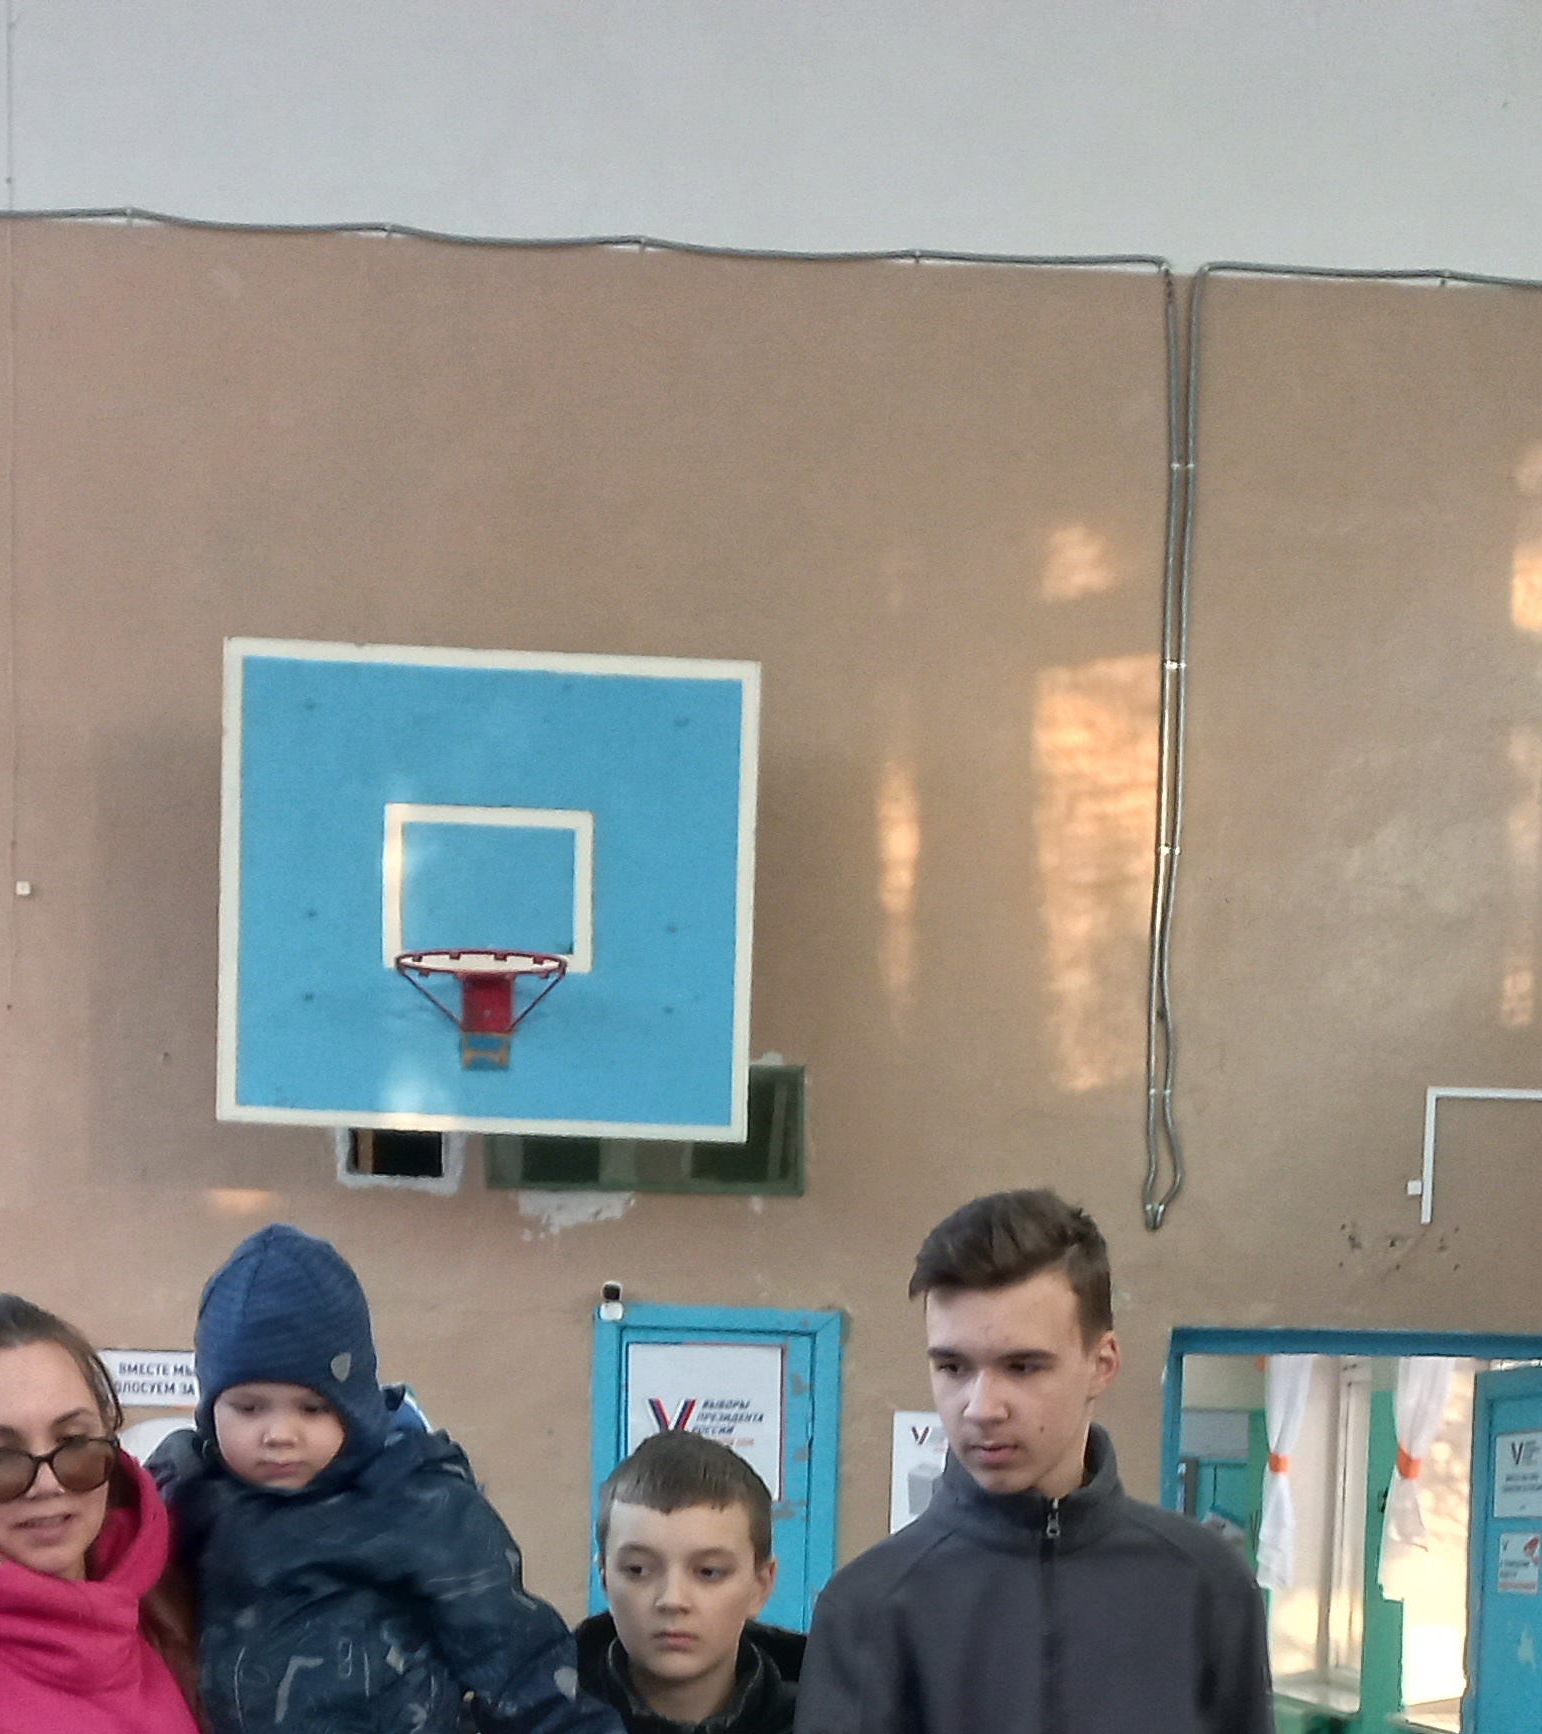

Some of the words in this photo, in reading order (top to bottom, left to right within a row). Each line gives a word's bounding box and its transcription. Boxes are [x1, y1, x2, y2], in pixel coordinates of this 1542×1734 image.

[119, 1363, 168, 1376] ВМЕСТЕ
[114, 1381, 175, 1394] ОЛОСУЕМ
[702, 1399, 750, 1410] ВЫБОРЫ
